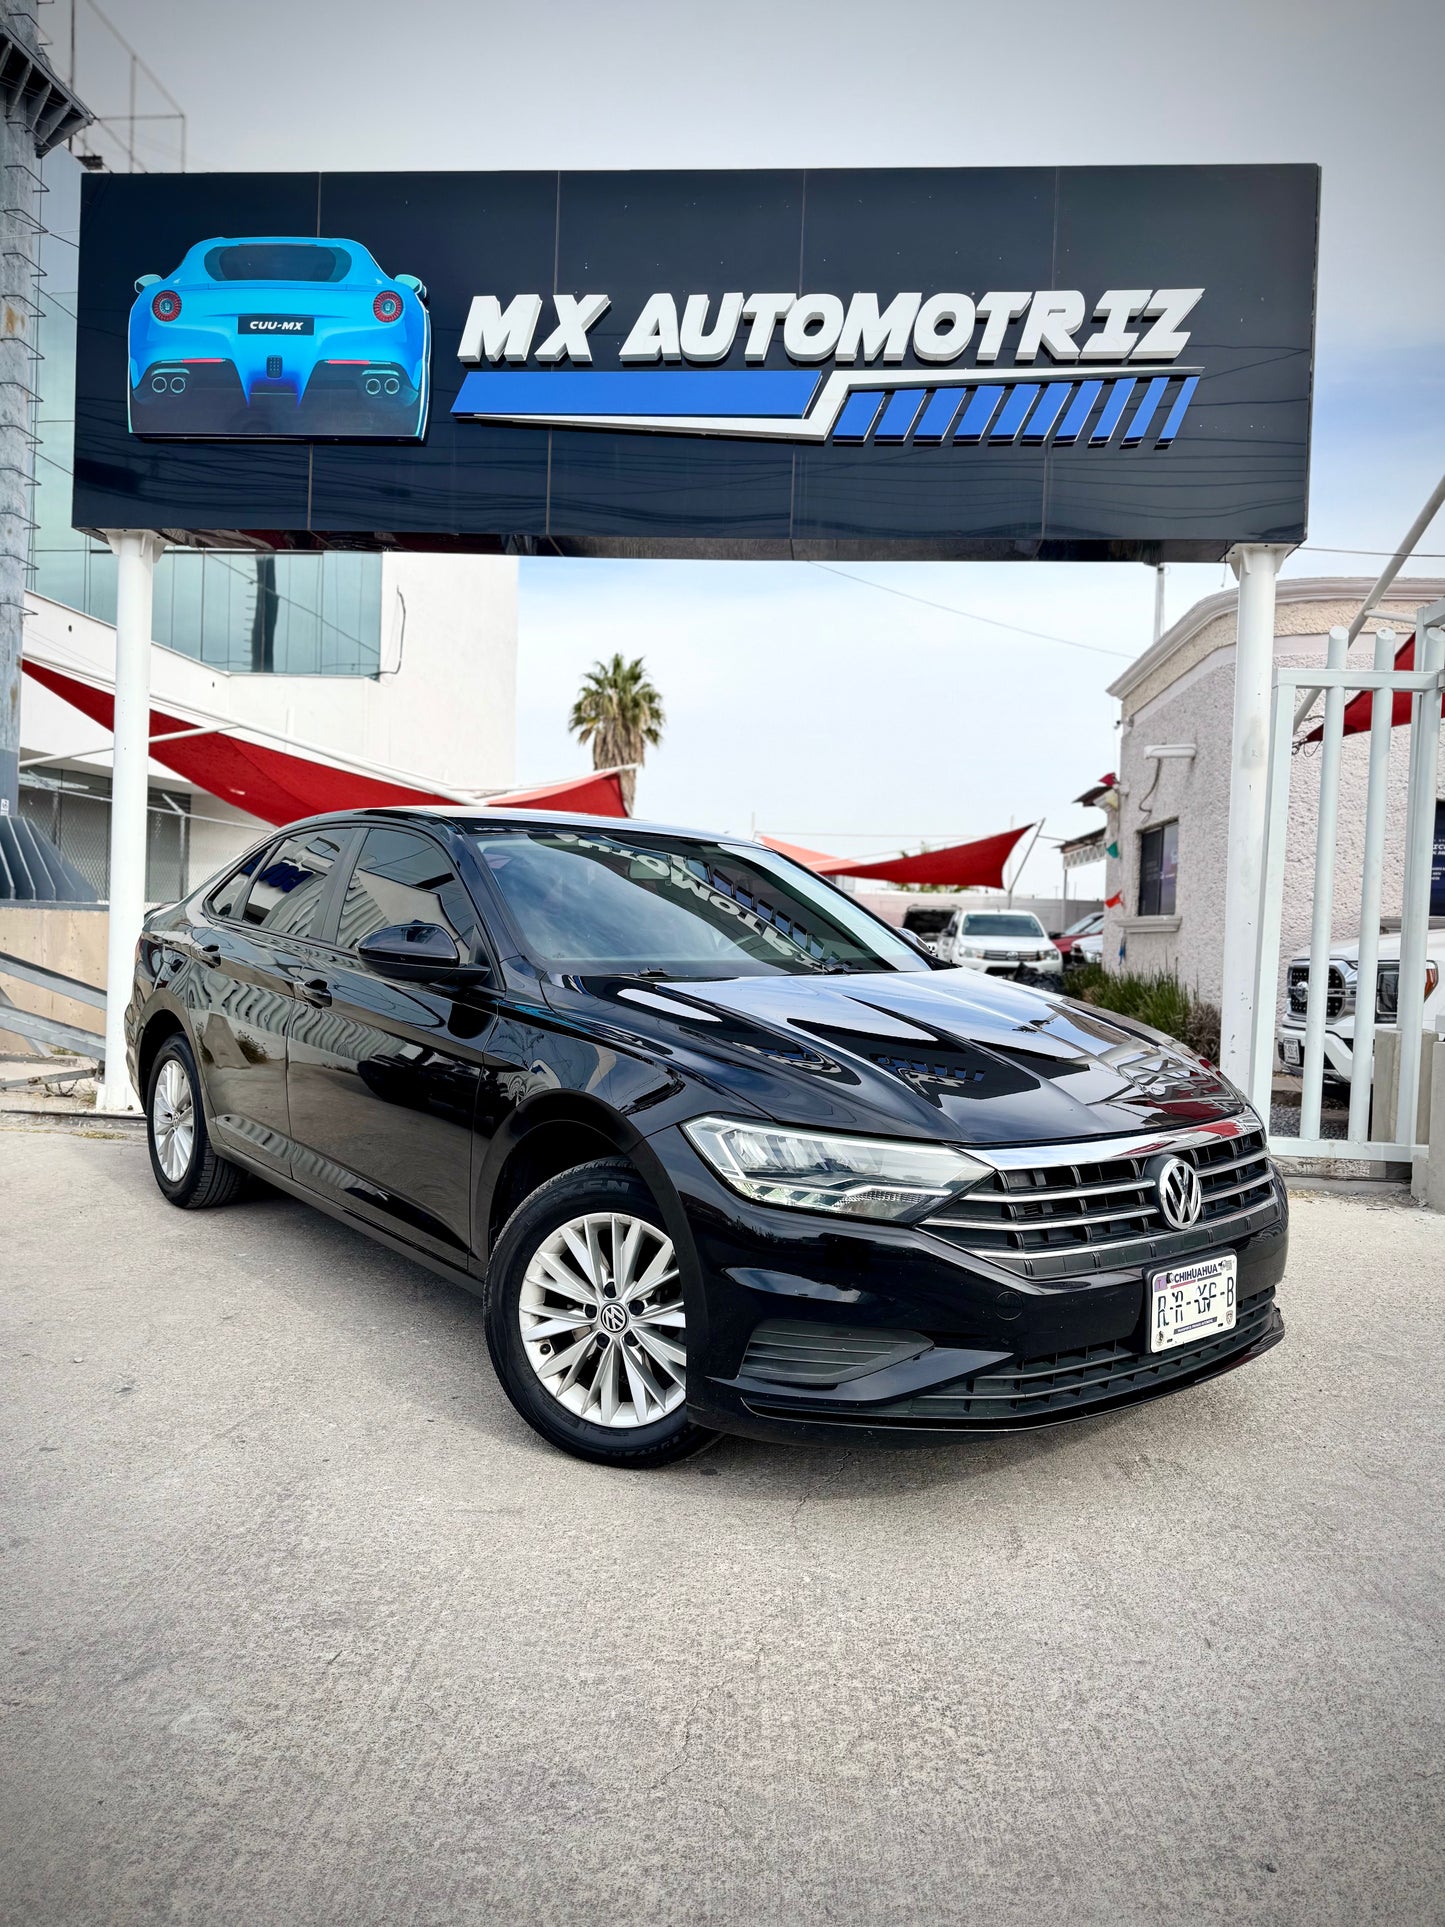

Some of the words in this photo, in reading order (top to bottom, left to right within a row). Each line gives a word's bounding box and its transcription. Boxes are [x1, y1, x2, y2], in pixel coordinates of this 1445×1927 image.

[250, 321, 304, 331] CUU-MX
[457, 293, 611, 362] MX
[619, 288, 1206, 362] AUTOMOTRIZ
[1174, 1263, 1218, 1283] CHIHUAHUA
